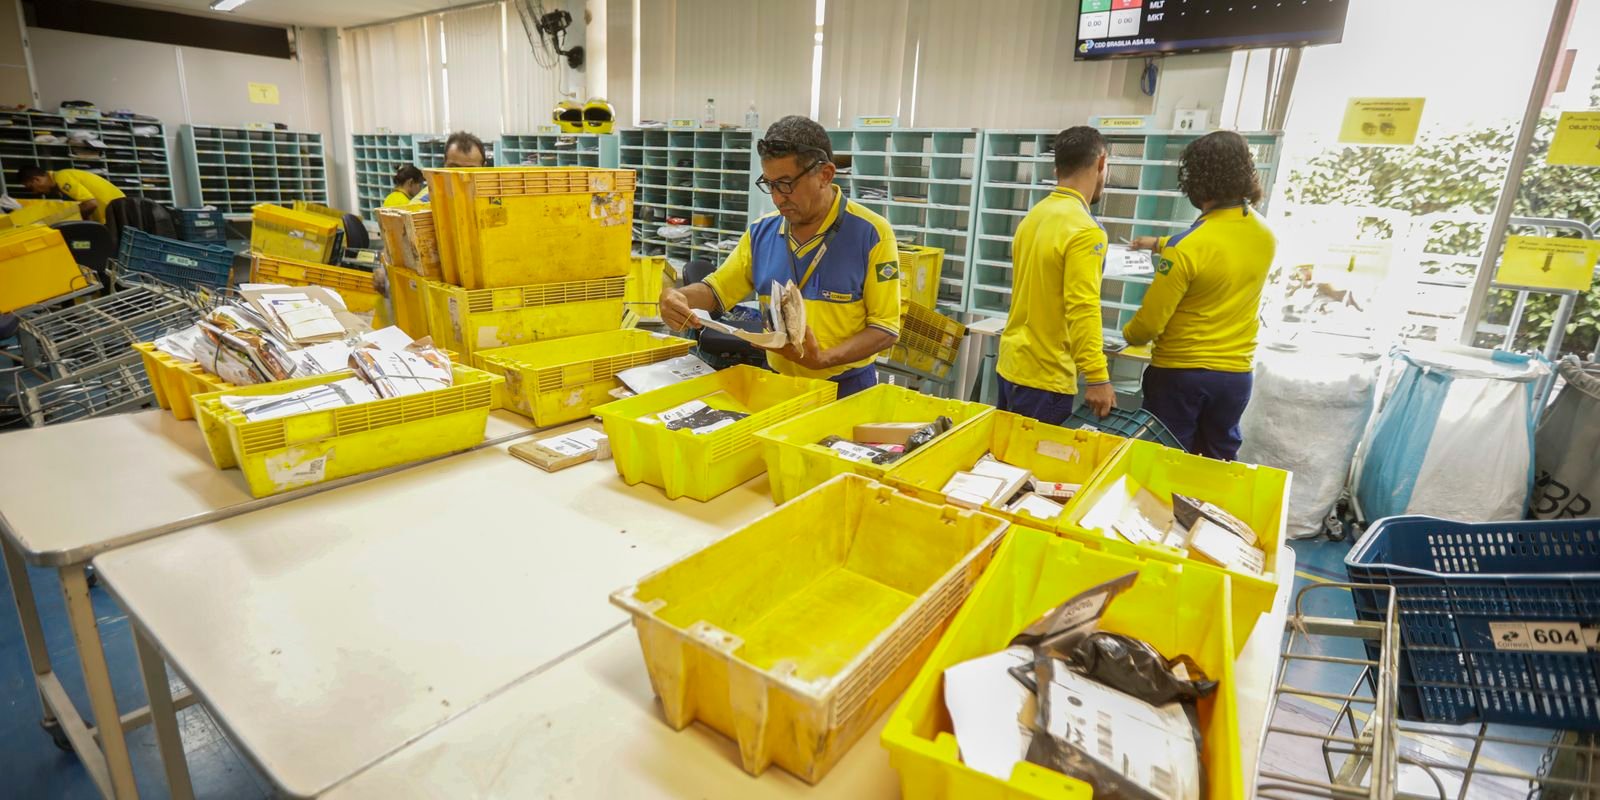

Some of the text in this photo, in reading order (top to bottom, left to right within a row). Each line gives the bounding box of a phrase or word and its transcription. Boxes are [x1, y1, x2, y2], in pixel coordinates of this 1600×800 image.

[1149, 0, 1165, 9] MLT
[1147, 13, 1164, 22] MKT
[1533, 628, 1579, 646] 604
